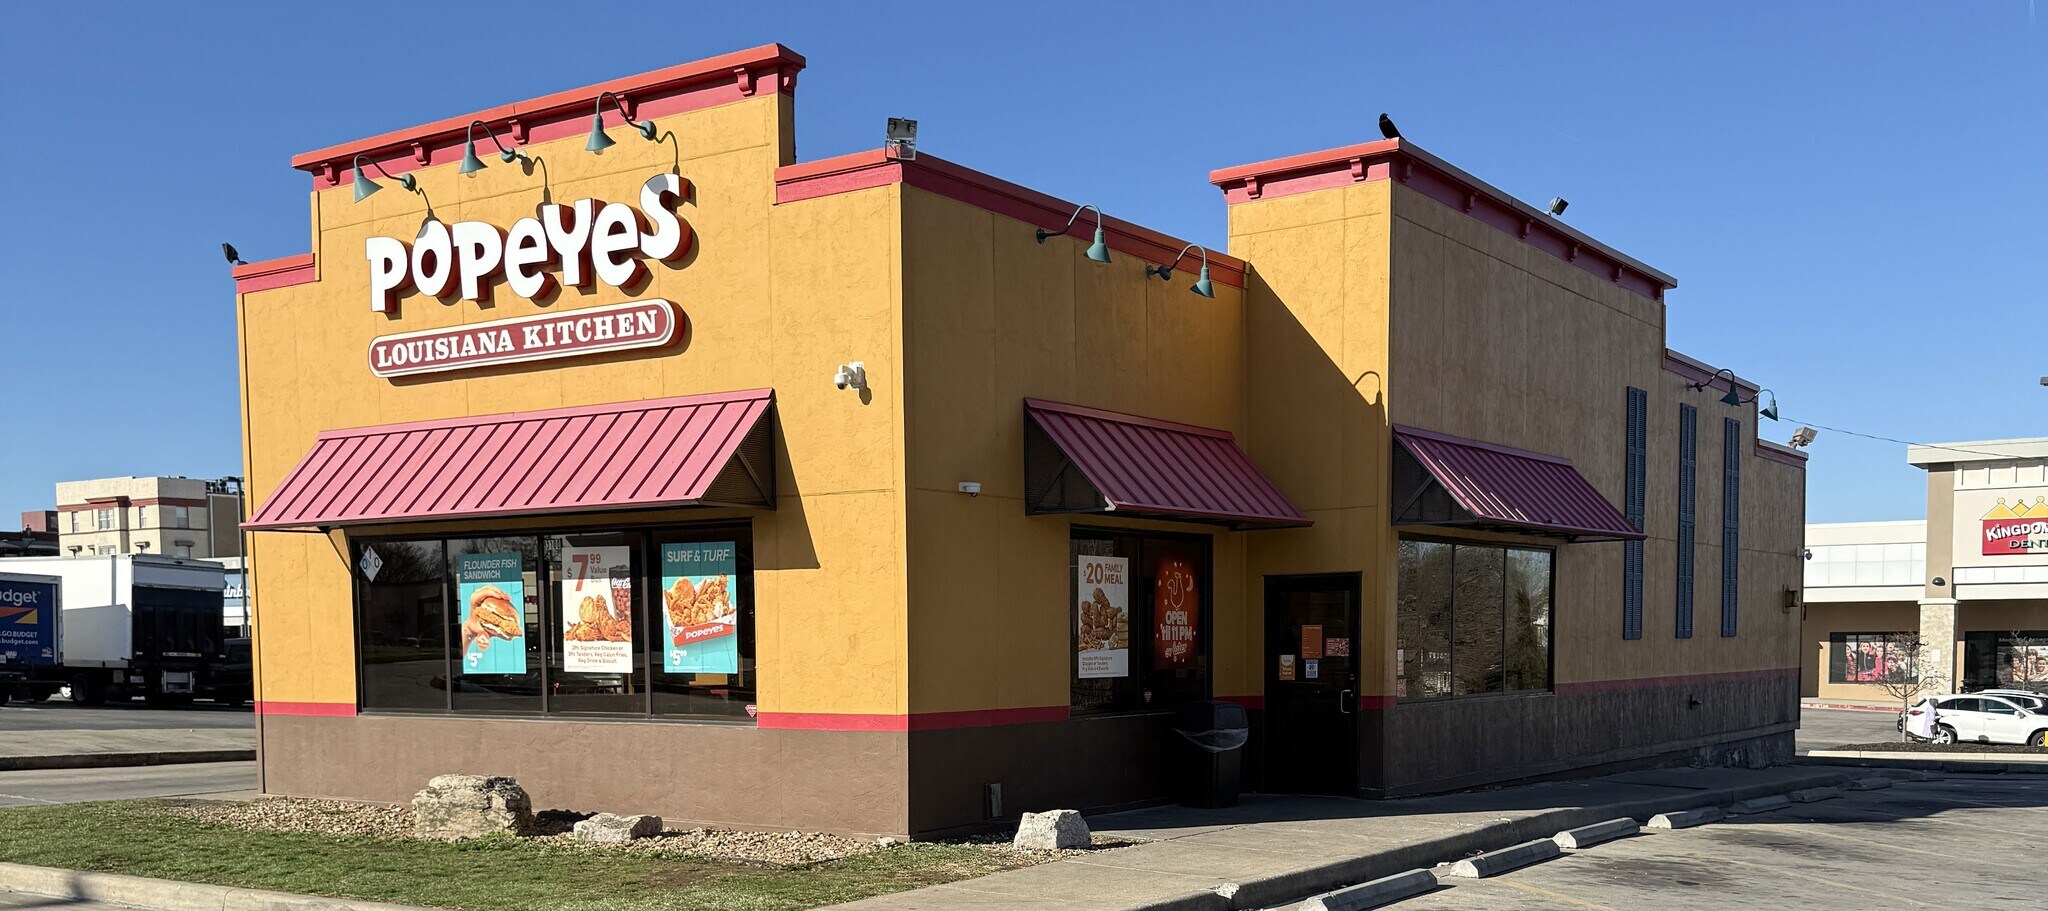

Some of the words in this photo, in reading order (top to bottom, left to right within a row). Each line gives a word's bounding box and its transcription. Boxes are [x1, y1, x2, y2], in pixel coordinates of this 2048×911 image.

[366, 174, 684, 312] POPEYES
[376, 329, 515, 368] LOUISIANA
[523, 309, 657, 349] KITCHEN
[667, 550, 693, 562] SURF
[694, 550, 701, 562] &
[703, 549, 730, 562] TURF
[464, 560, 500, 570] FLOUNDER
[501, 559, 517, 568] FISH
[590, 566, 607, 574] Value
[1105, 563, 1124, 573] FAMILY
[464, 570, 501, 580] SANDWICH
[1105, 573, 1124, 585] MEAL
[1165, 610, 1188, 625] OPEN
[685, 624, 724, 640] POPEYES
[1180, 626, 1193, 641] PM
